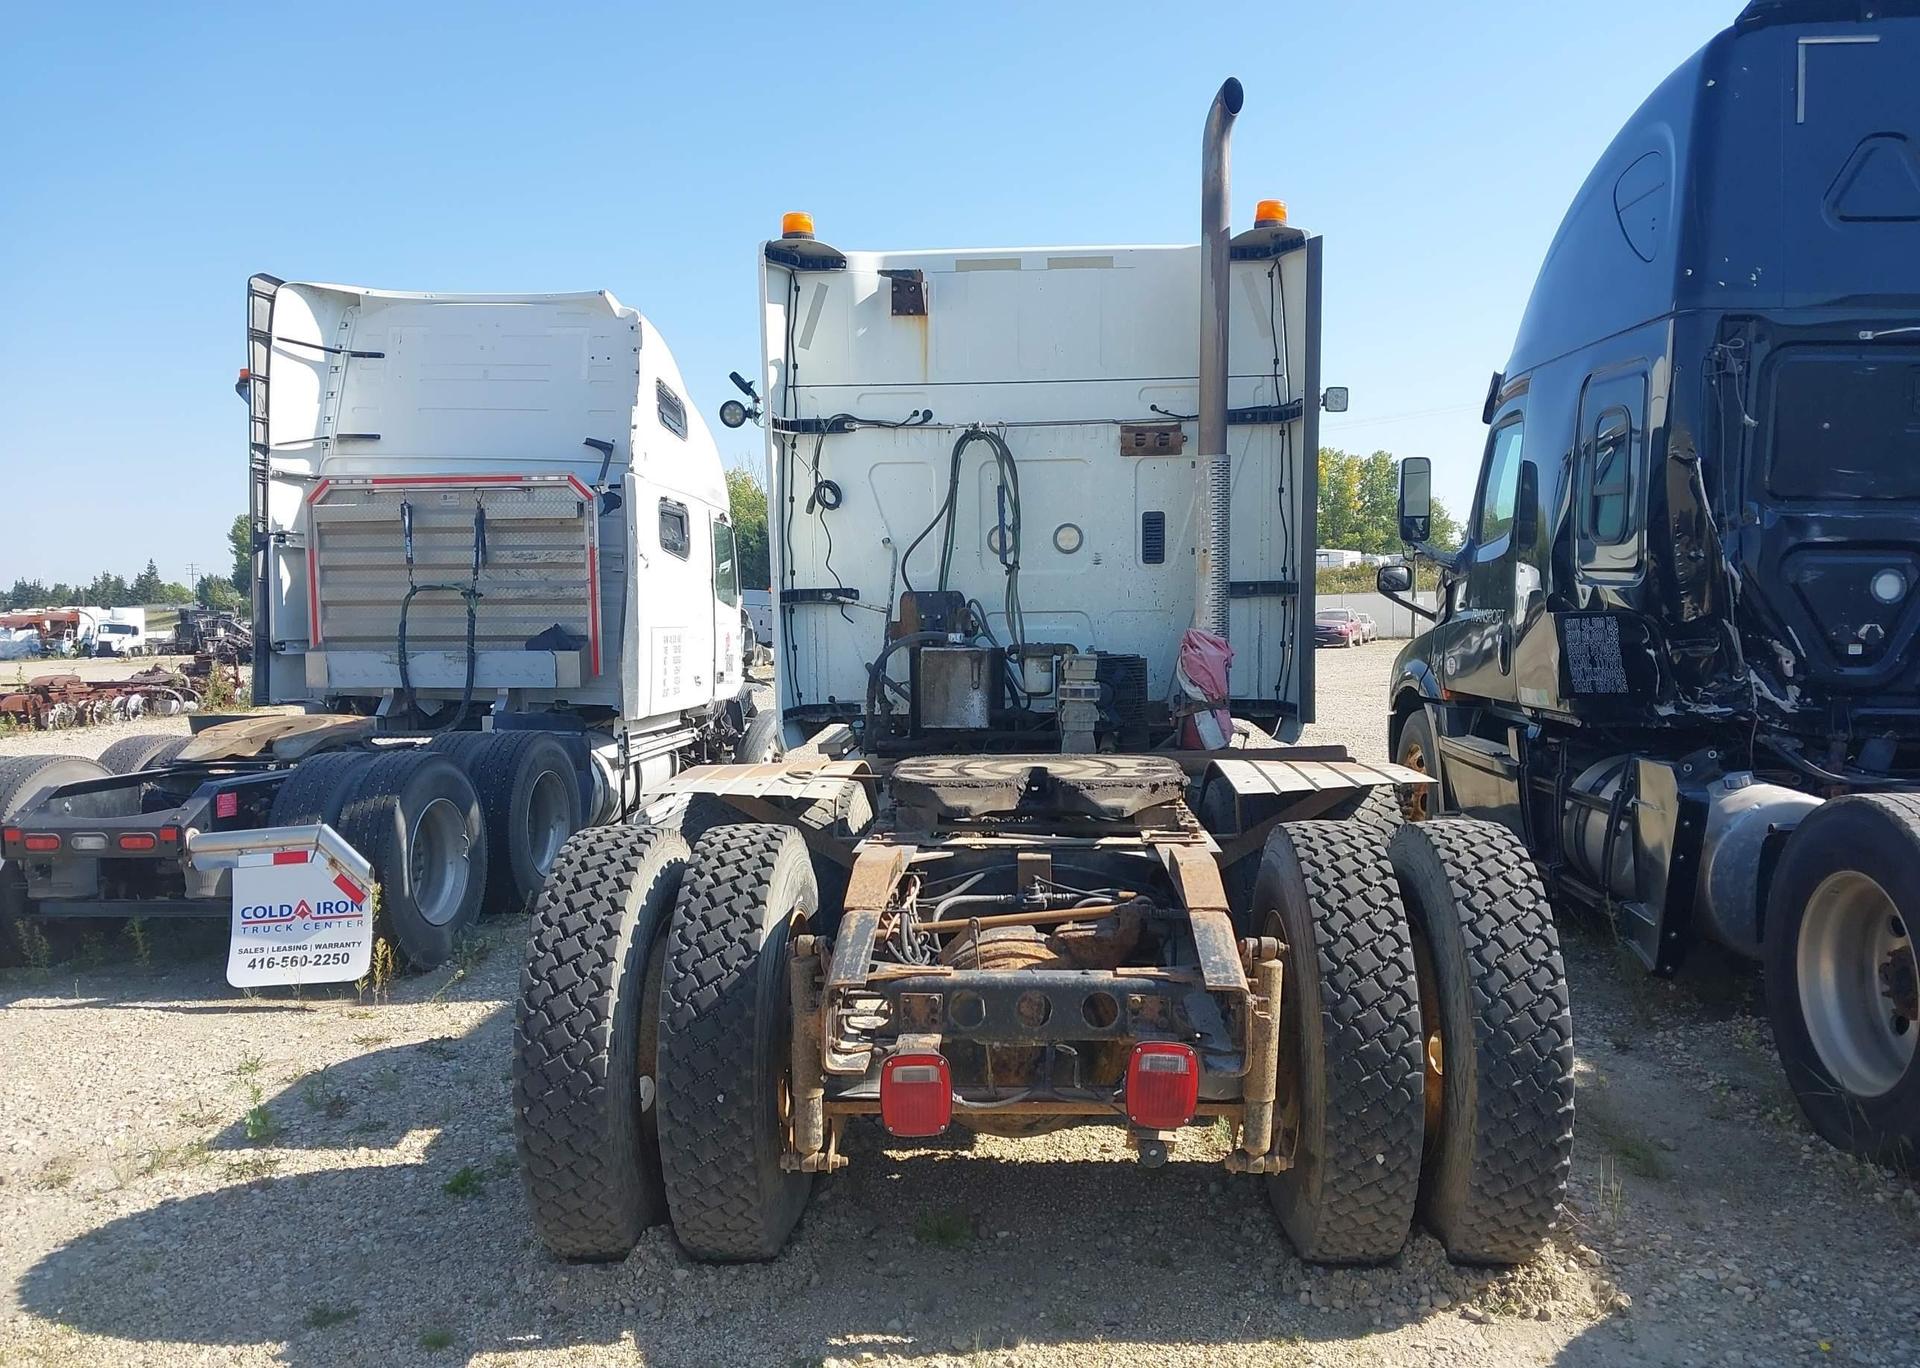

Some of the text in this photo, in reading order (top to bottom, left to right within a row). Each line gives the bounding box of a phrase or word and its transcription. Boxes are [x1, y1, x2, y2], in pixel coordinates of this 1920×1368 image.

[240, 900, 363, 920] COLD IRON
[241, 919, 364, 935] TRUCK CENTER
[238, 940, 362, 955] SALES LEASING WARRANTY
[247, 952, 350, 970] 416-560-2250
